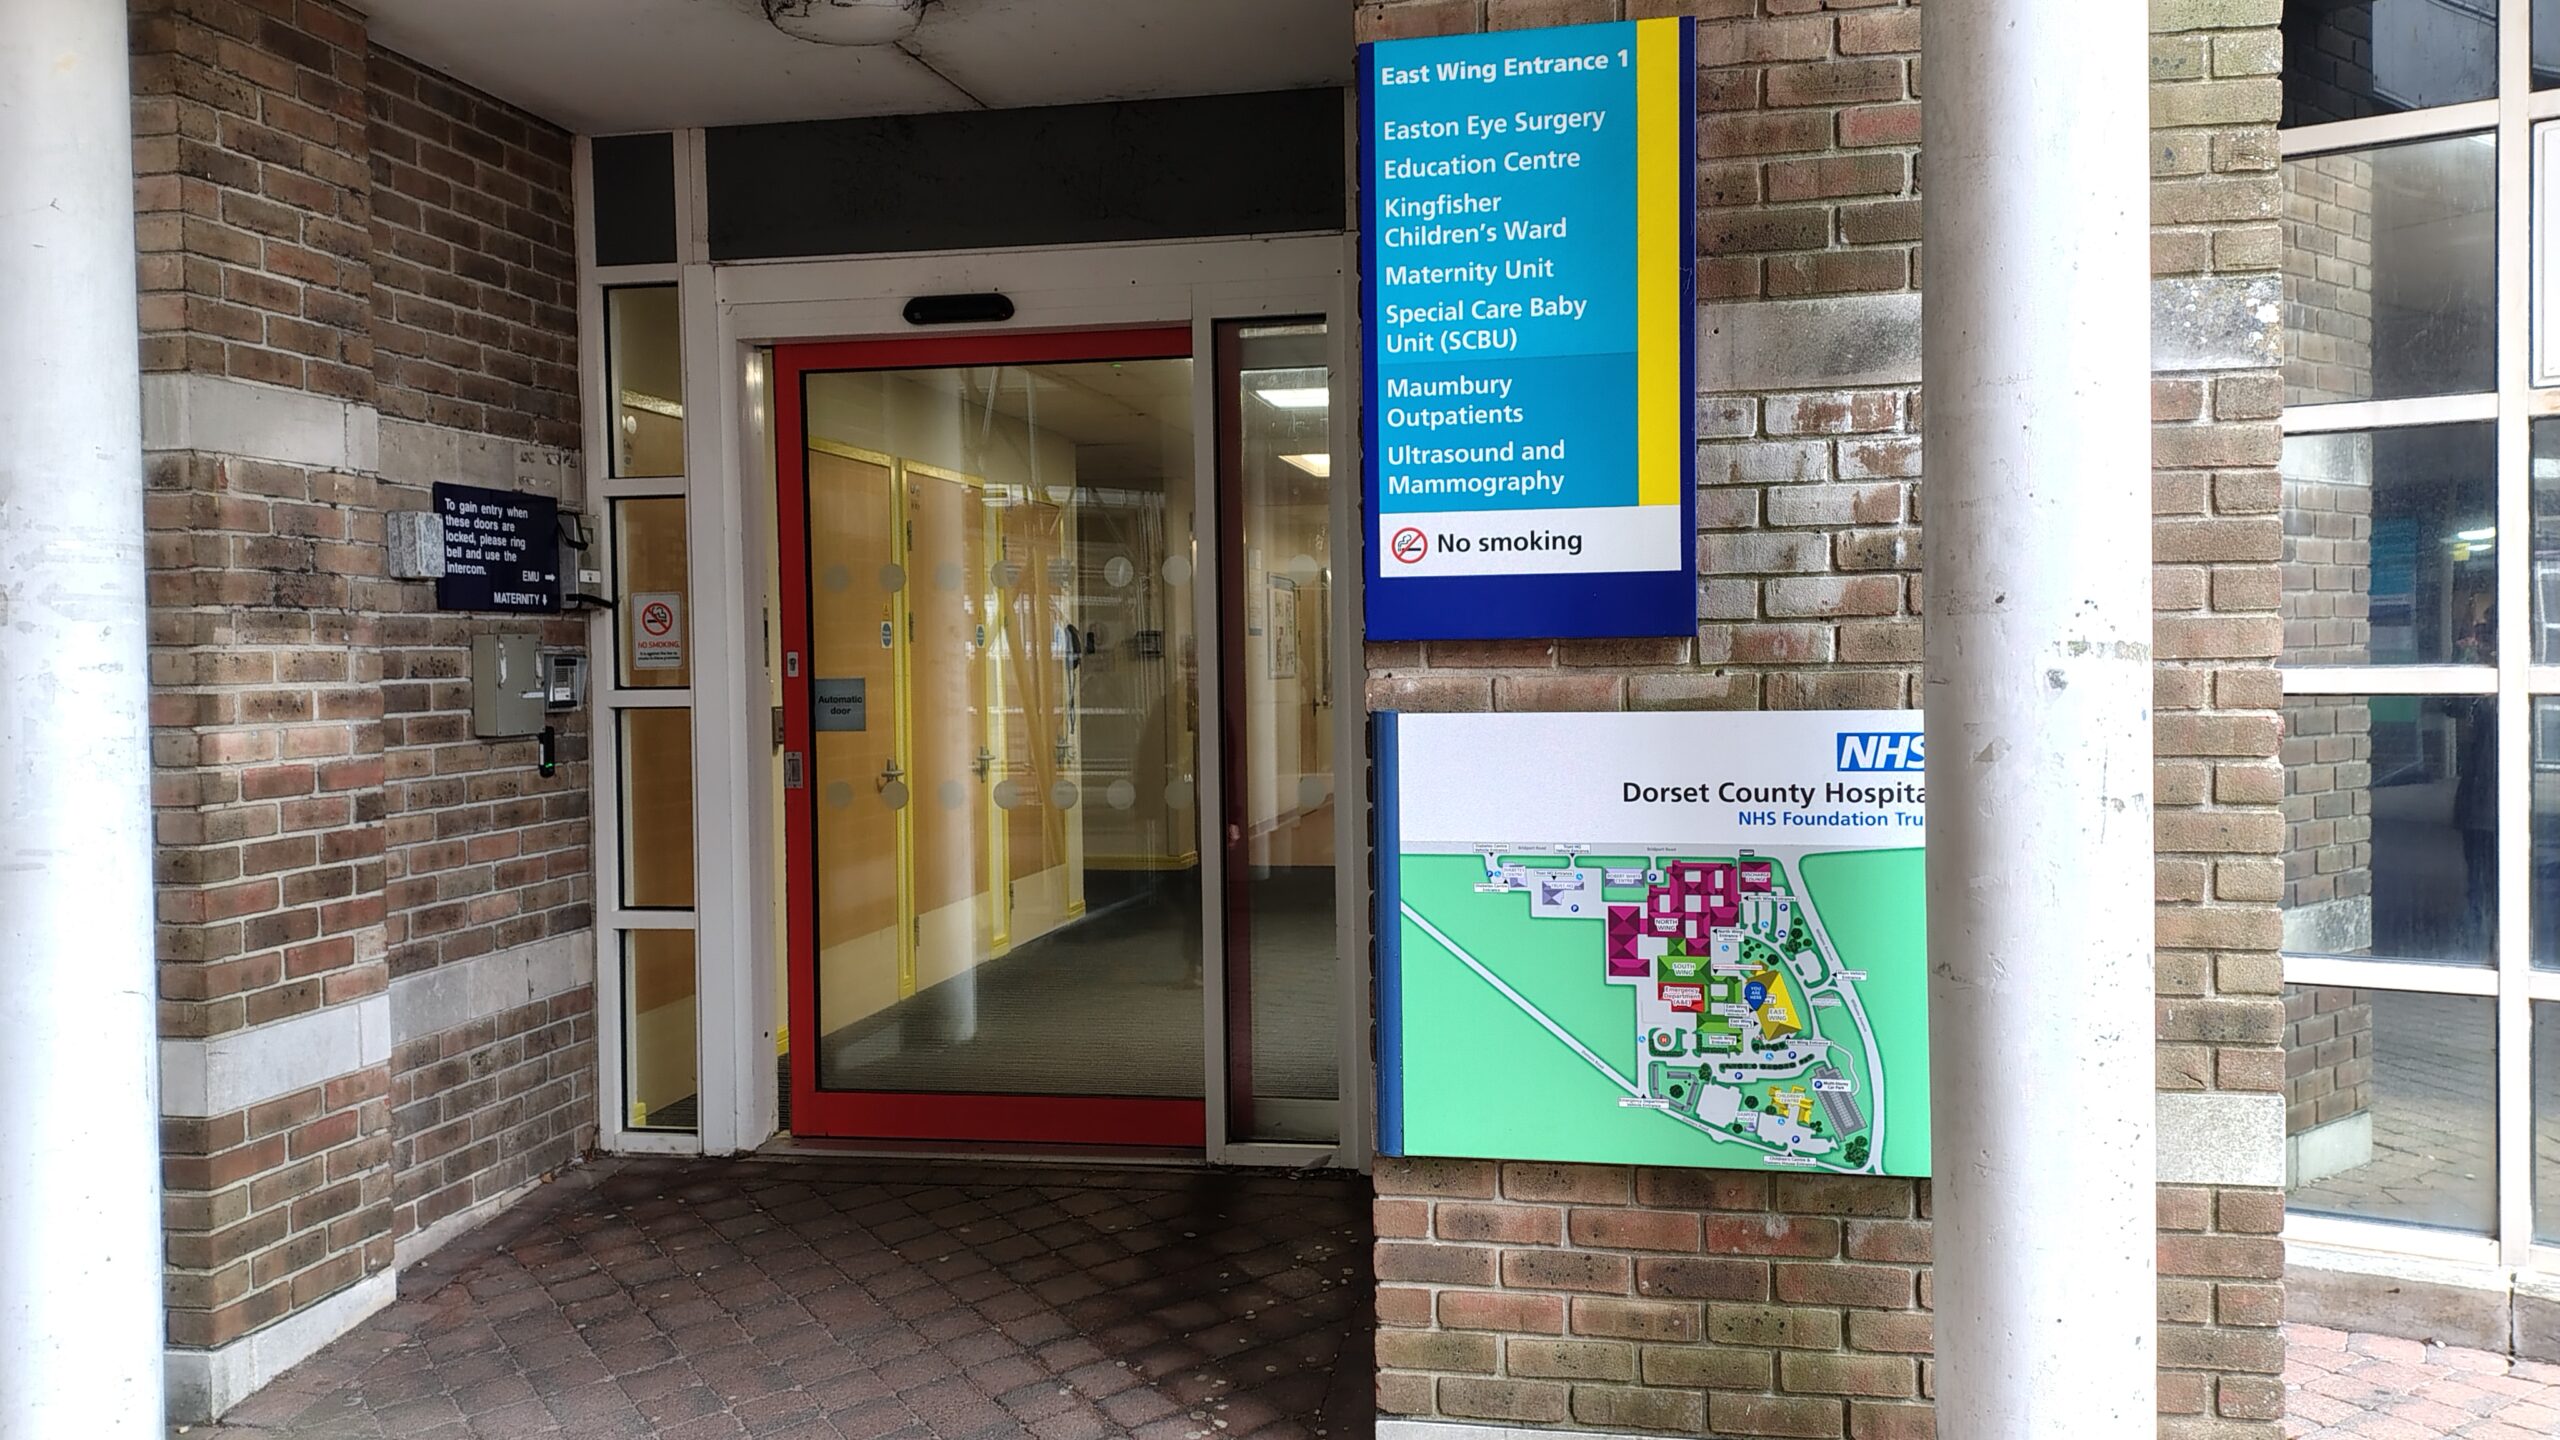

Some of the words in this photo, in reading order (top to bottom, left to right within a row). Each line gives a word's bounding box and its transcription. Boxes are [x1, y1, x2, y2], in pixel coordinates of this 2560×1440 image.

[1382, 65, 1431, 86] East
[1437, 60, 1497, 82] Wing
[1504, 54, 1609, 77] Entrance
[1618, 49, 1628, 68] 1
[1384, 120, 1459, 141] Easton
[1468, 115, 1507, 139] Eye
[1515, 110, 1606, 135] Surgery
[1384, 154, 1496, 180] Education
[1504, 150, 1581, 172] Centre
[1385, 193, 1502, 221] Kingfisher
[1504, 217, 1567, 241] Ward
[1386, 262, 1497, 286] Maternity
[1505, 259, 1555, 280] Unit
[1387, 300, 1464, 328] Special
[1471, 300, 1523, 320] Care
[1531, 295, 1588, 320] Baby
[1387, 333, 1435, 353] Unit
[1441, 328, 1518, 353] (SCBU)
[1388, 375, 1513, 398] Maumbury
[1388, 405, 1524, 430] Outpatients
[1388, 441, 1514, 465] Ultrasound
[1522, 439, 1565, 461] and
[1389, 470, 1565, 497] Mammography
[445, 498, 456, 511] To
[459, 501, 478, 515] gain
[481, 504, 503, 519] entry
[507, 506, 529, 519] when
[445, 514, 471, 528] these
[474, 517, 499, 531] doors
[502, 522, 516, 532] are
[446, 530, 477, 546] locked,
[480, 533, 507, 547] please
[510, 536, 526, 551] ring
[1438, 534, 1471, 553] No
[1479, 530, 1582, 555] smoking
[446, 546, 462, 558] bell
[466, 548, 482, 560] and
[485, 551, 501, 561] use
[504, 551, 518, 562] the
[447, 561, 487, 575] intercom.
[522, 570, 540, 582] EMU
[493, 592, 540, 605] MATERNITY
[818, 695, 863, 704] Automatic
[830, 706, 852, 715] door
[1840, 735, 1925, 769] NHS
[1623, 782, 1710, 802] Dorset
[1718, 782, 1816, 808] County
[1826, 781, 1925, 808] Hospita
[1739, 811, 1777, 826] NHS
[1784, 811, 1889, 826] Foundation
[1895, 811, 1924, 826] Tru
[1665, 986, 1698, 994] Emergency
